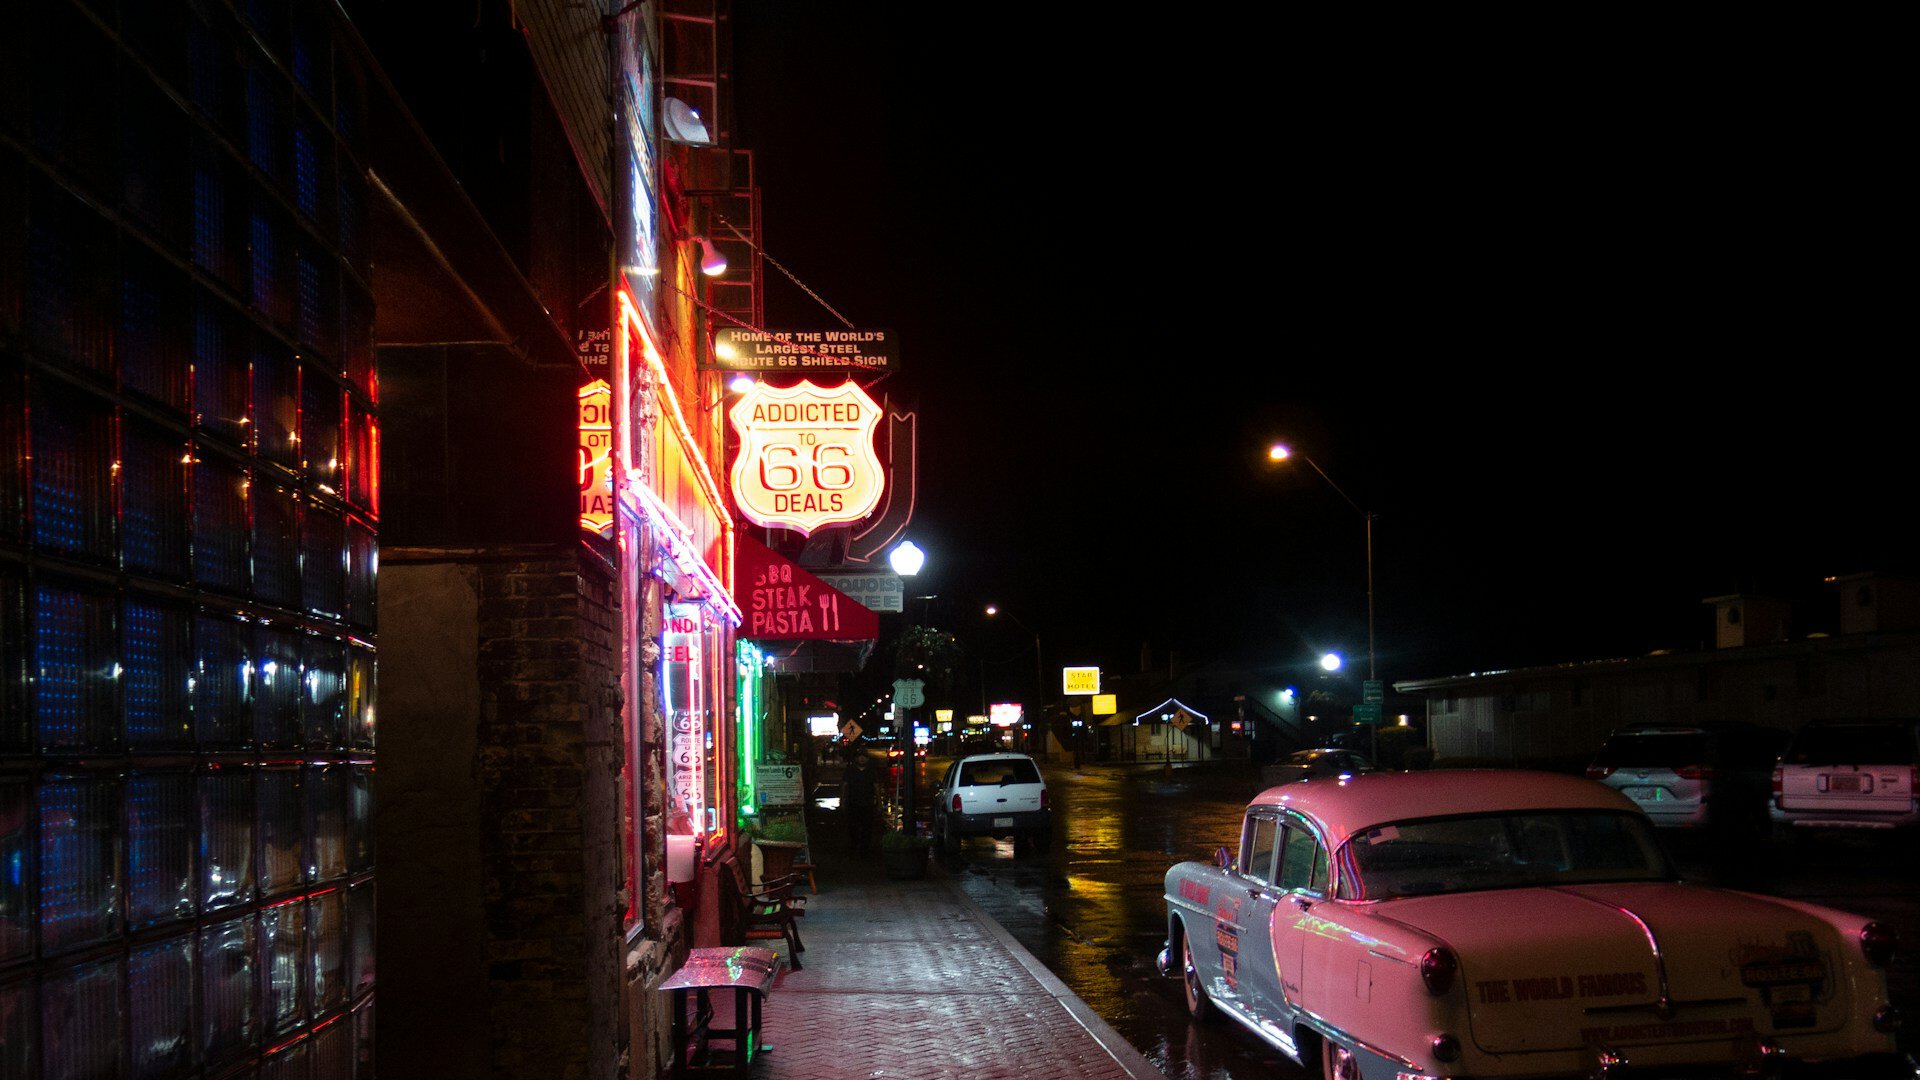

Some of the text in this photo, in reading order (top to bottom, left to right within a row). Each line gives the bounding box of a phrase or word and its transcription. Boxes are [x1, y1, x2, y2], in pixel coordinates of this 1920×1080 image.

[796, 332, 822, 342] THE
[756, 343, 861, 354] LARGEST STEEL
[778, 356, 798, 366] 66
[801, 356, 850, 366] SHIELD
[854, 356, 888, 366] SIGN
[752, 403, 860, 423] ADDICTED
[798, 433, 816, 446] TO
[759, 442, 857, 491] 66
[775, 493, 844, 513] DEALS
[751, 585, 813, 611] STEAK
[751, 609, 815, 636] PASTA
[1475, 971, 1649, 1004] THE WORLD FAMOUS
